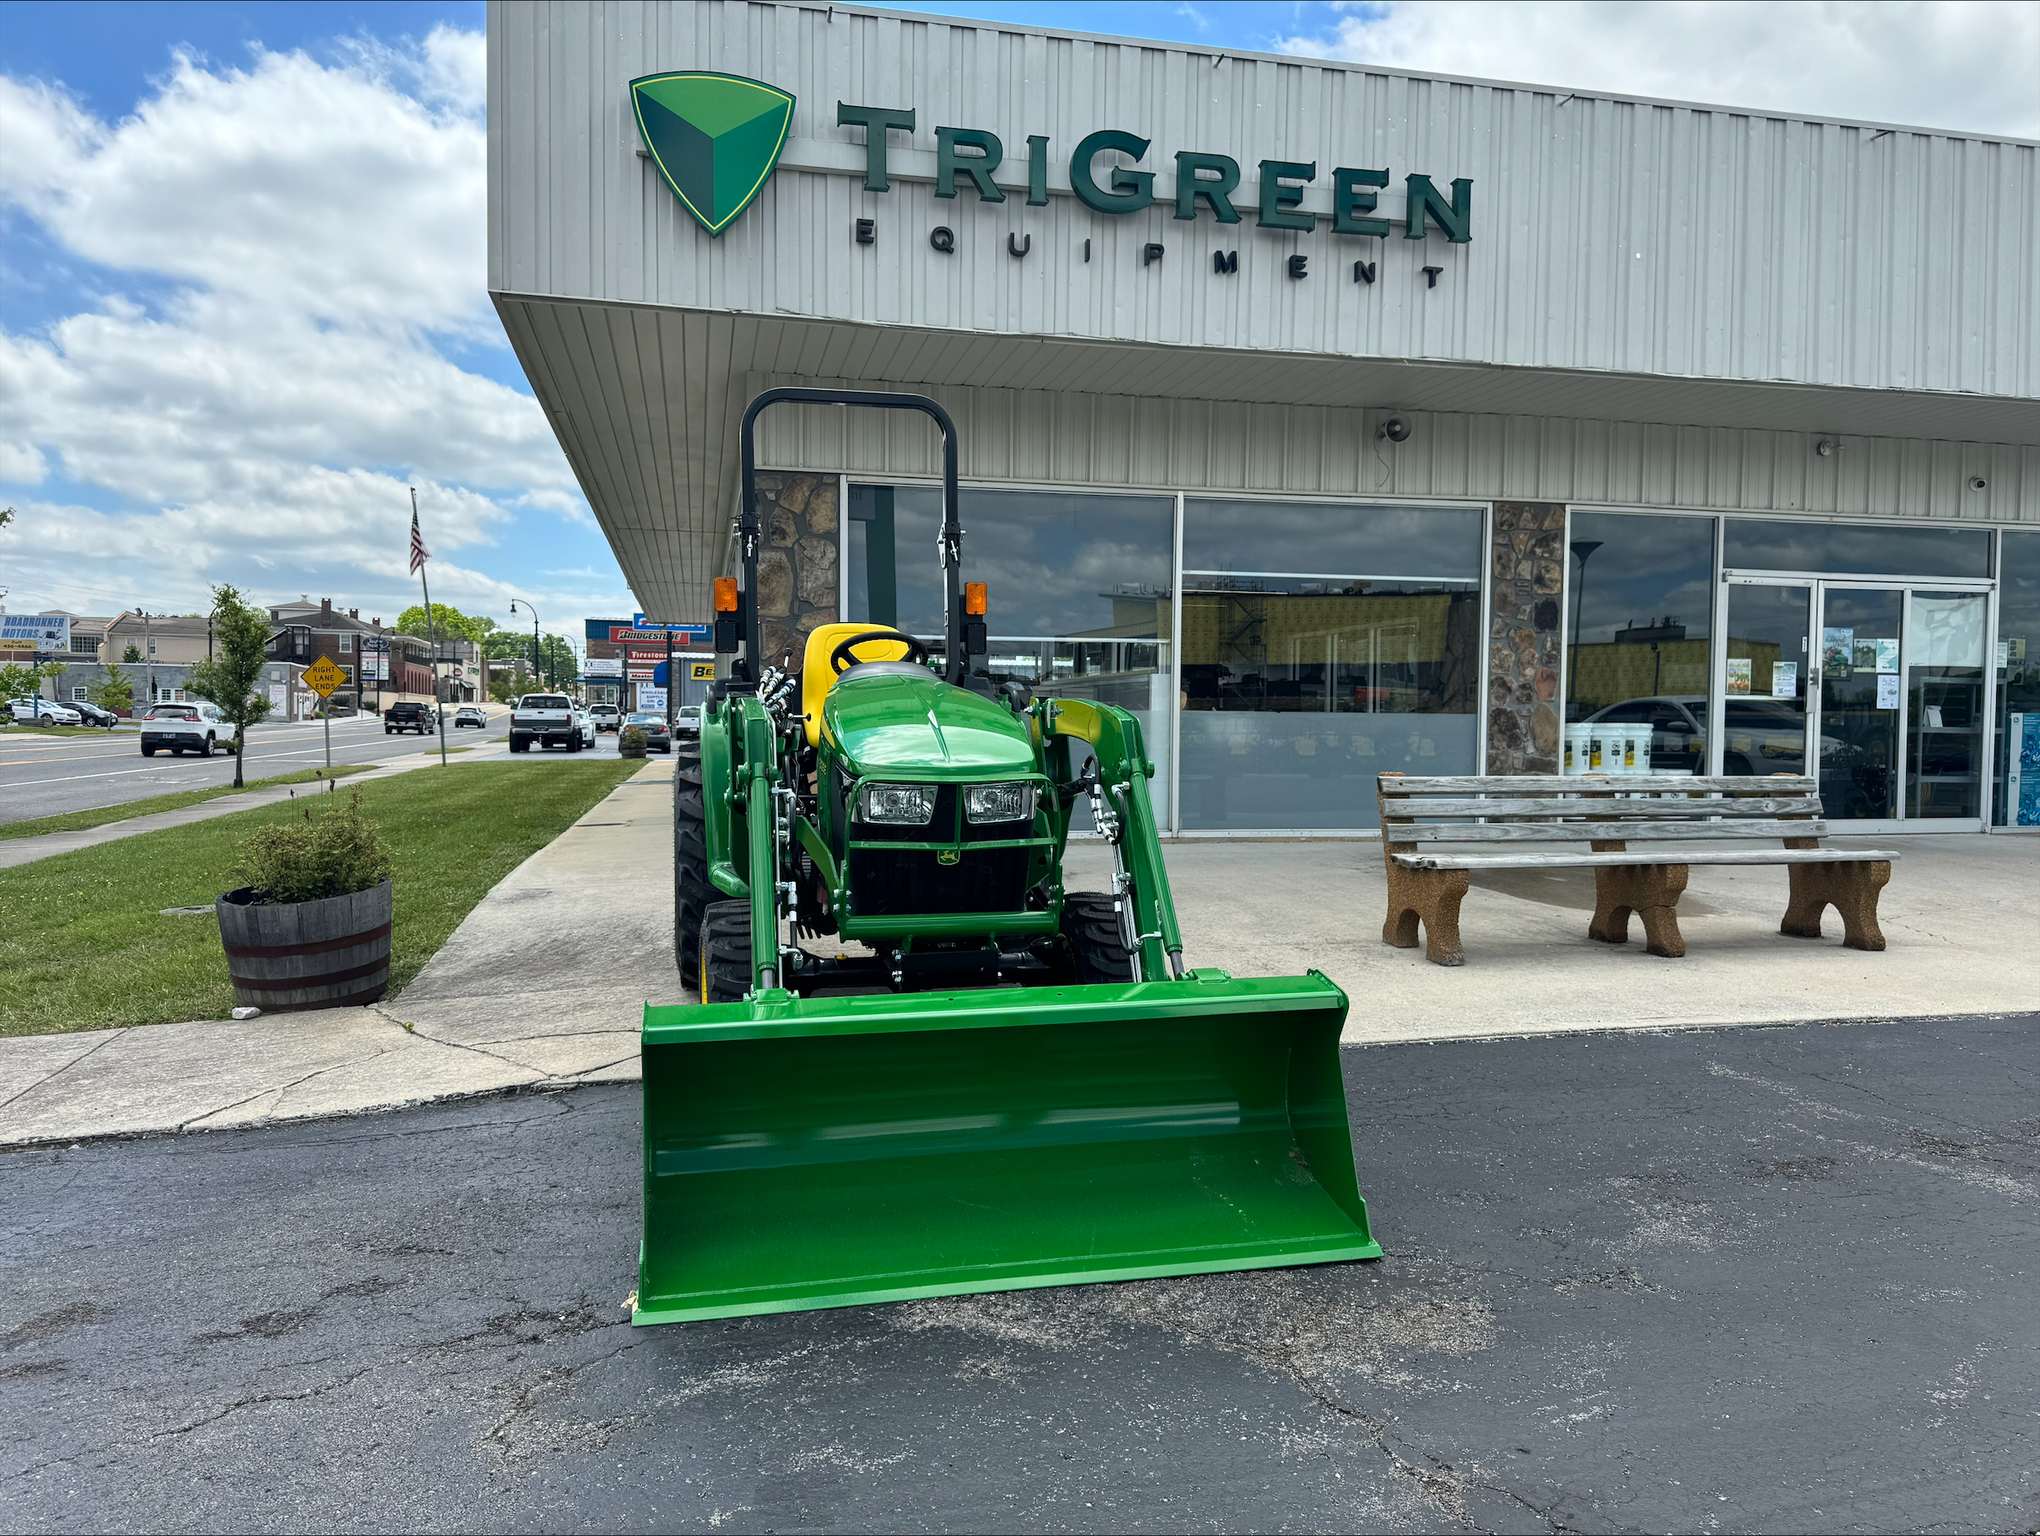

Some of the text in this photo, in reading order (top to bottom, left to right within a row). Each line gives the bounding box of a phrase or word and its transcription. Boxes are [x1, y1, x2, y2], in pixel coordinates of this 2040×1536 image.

[837, 100, 1474, 244] TRIGREEN
[855, 218, 1444, 289] EQUIPMENT
[4, 616, 65, 627] ROADRUNNER
[1, 628, 39, 638] MOTORS
[631, 651, 667, 659] Firestone
[314, 674, 335, 682] LANE
[315, 682, 336, 690] ENDS
